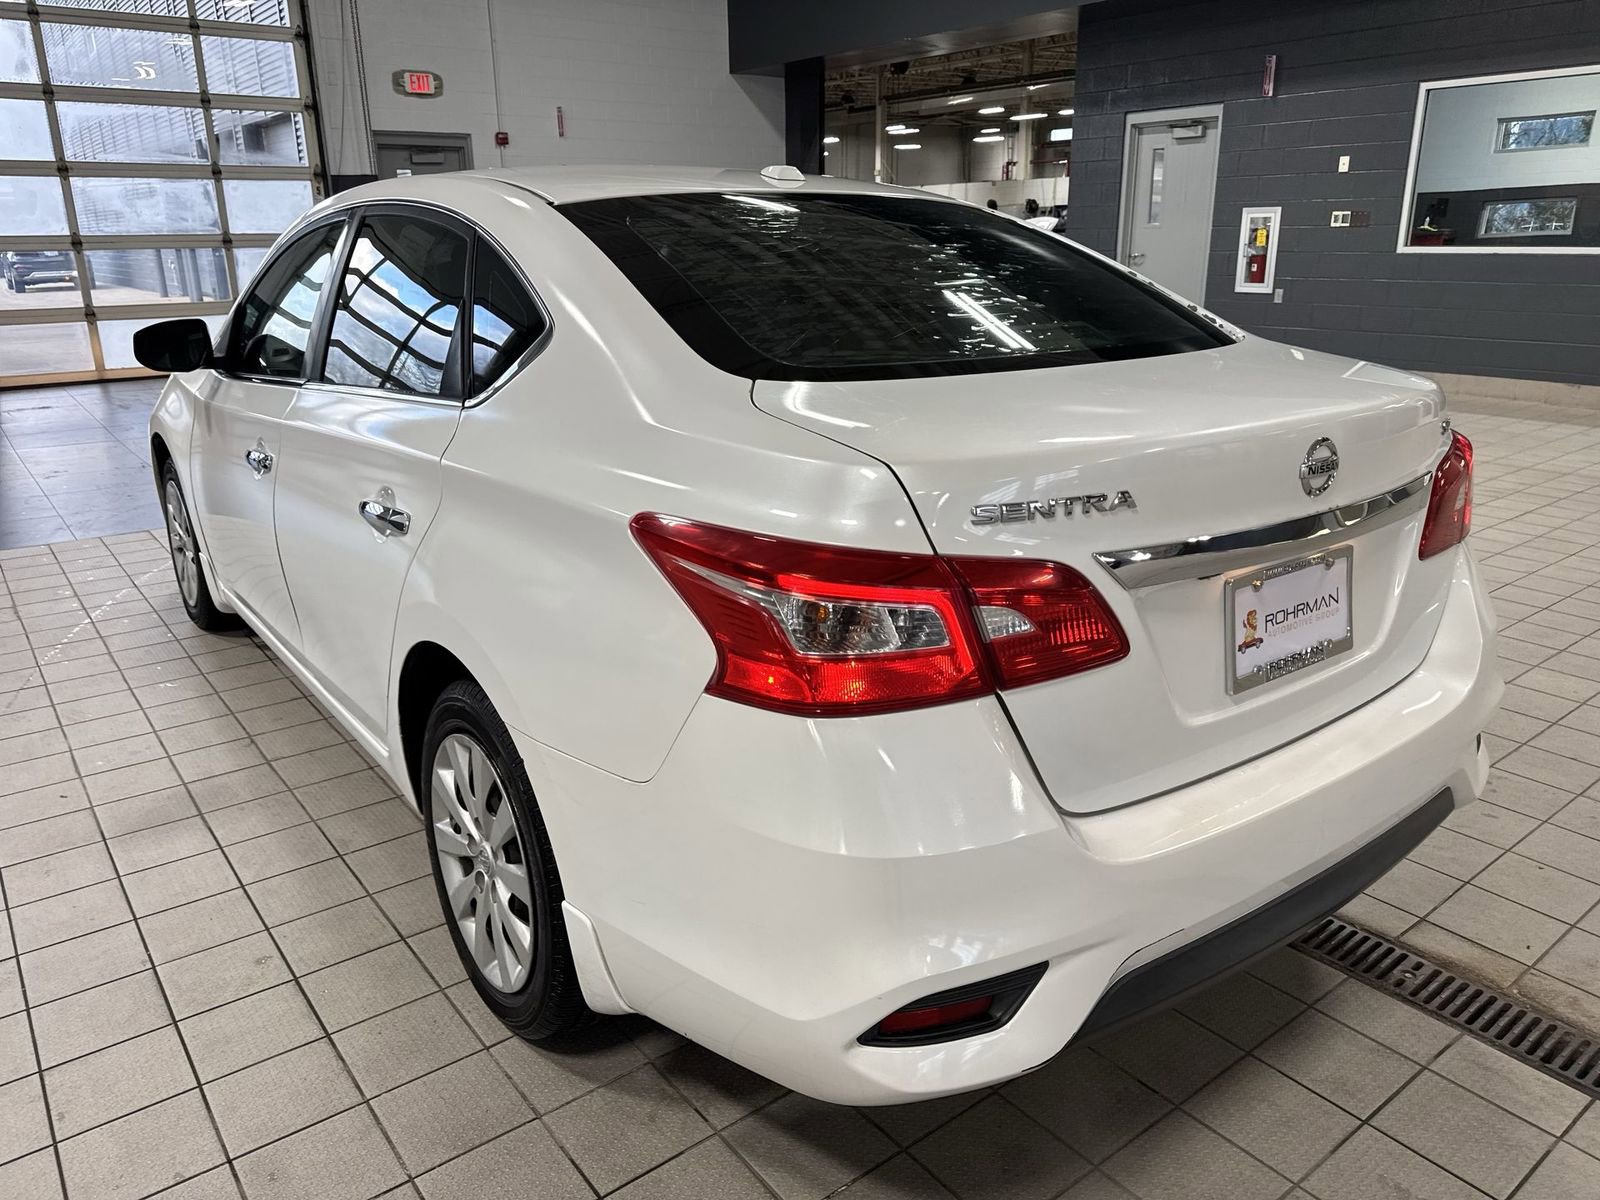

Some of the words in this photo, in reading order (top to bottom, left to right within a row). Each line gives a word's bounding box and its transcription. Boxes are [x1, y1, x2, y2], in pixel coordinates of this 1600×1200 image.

[409, 74, 430, 91] EXIT
[971, 491, 1137, 526] SENTRA
[1265, 587, 1339, 633] ROHRMAN
[1267, 617, 1313, 638] AUTOMOTIVE
[1315, 607, 1340, 622] GROUP
